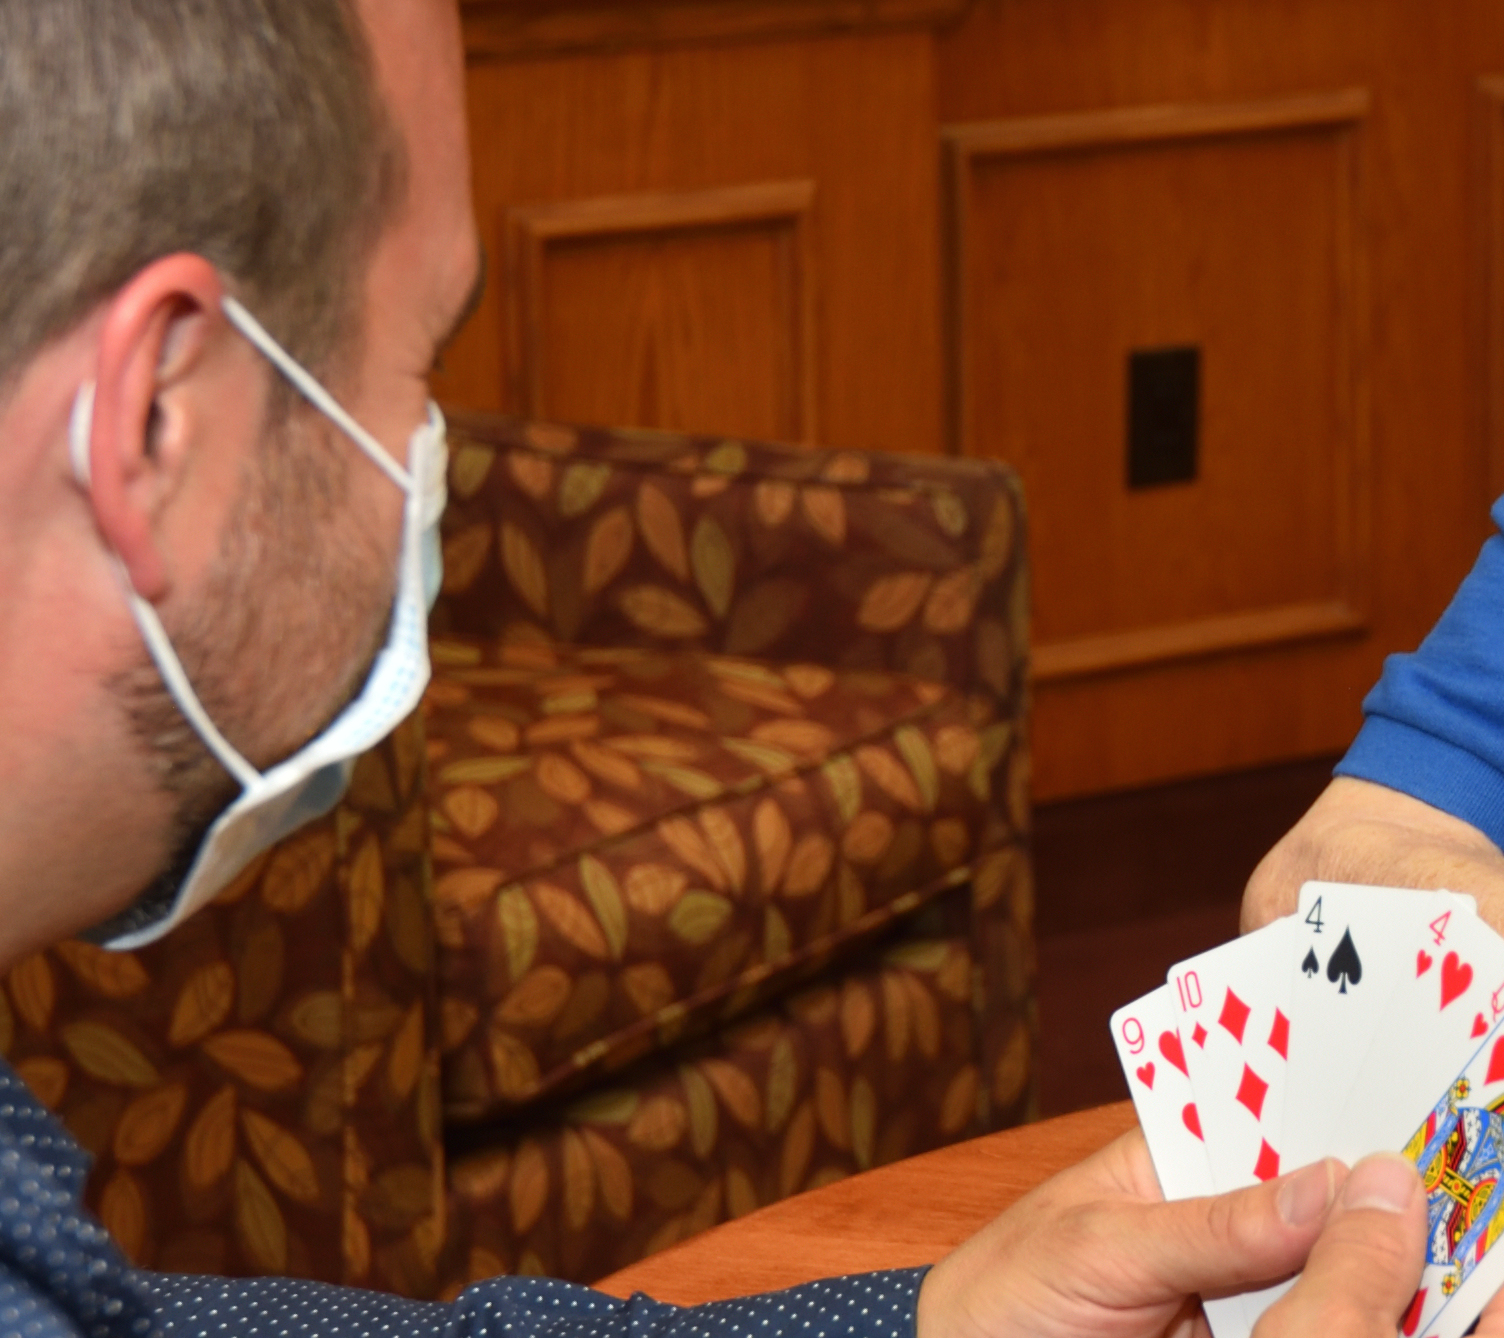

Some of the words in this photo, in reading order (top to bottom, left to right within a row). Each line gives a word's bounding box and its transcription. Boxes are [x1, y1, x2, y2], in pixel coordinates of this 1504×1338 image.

[1304, 895, 1325, 934] 4
[1428, 909, 1453, 947] 4
[1176, 969, 1203, 1013] 10
[1121, 1016, 1145, 1055] 9
